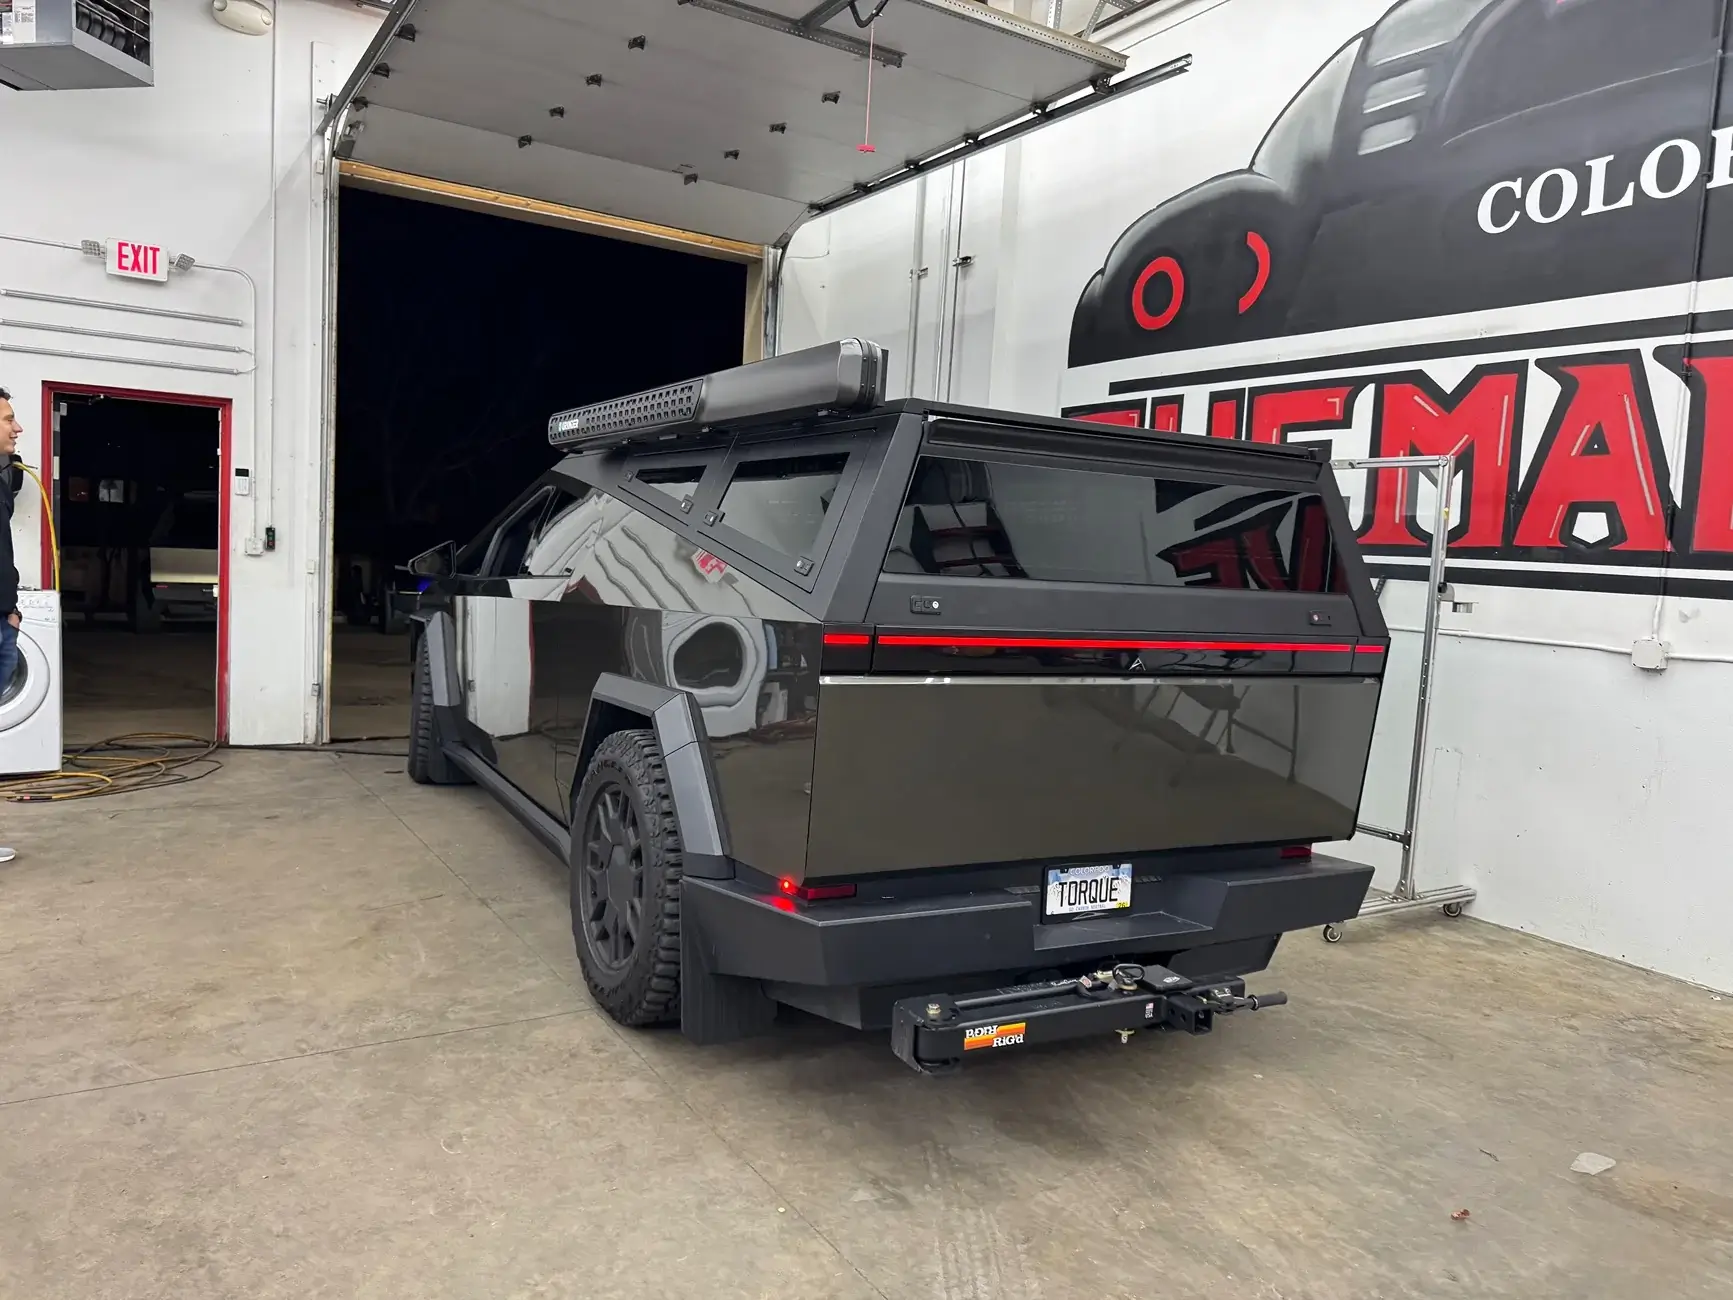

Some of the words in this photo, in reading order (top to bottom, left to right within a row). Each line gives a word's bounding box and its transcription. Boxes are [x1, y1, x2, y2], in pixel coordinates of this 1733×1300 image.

[117, 242, 160, 275] EXIT
[1070, 866, 1109, 875] COLORADO
[1058, 877, 1120, 907] TORQUE
